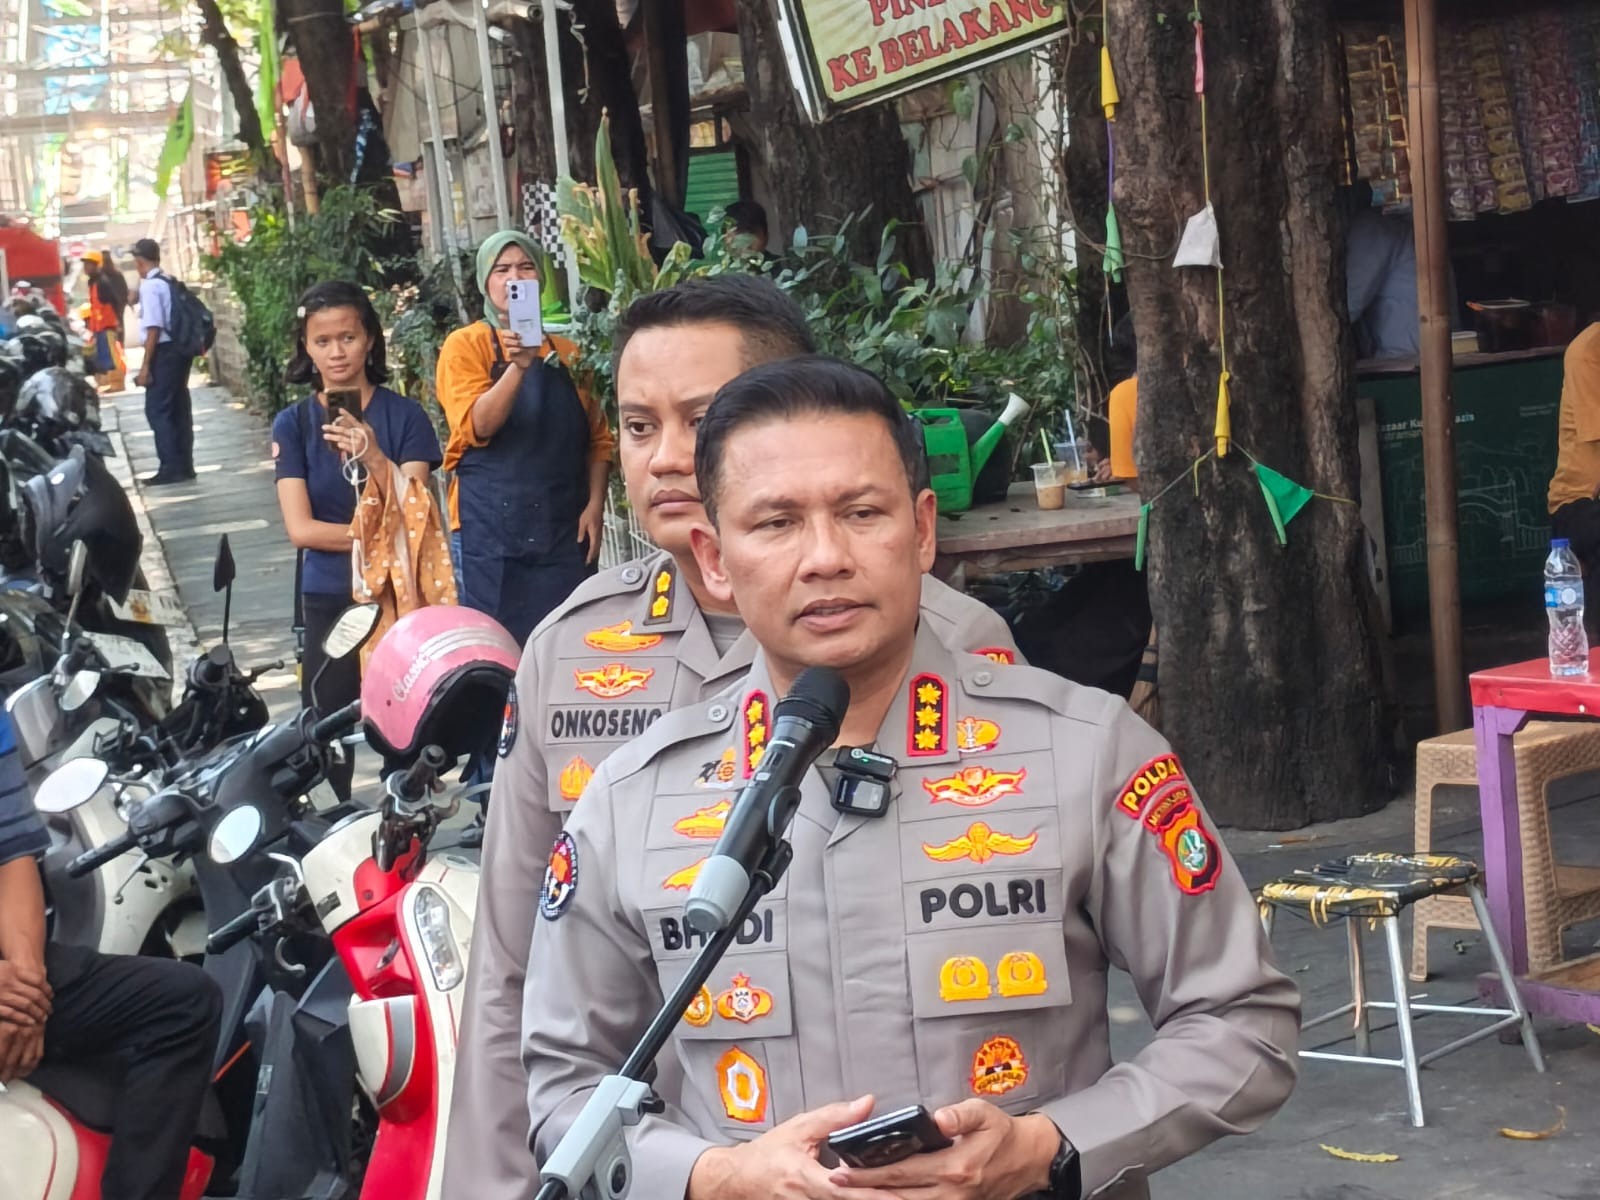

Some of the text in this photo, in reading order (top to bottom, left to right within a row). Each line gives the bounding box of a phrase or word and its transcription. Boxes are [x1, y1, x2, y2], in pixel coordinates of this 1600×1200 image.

[826, 46, 877, 92] KE
[1123, 758, 1179, 811] POLDA
[920, 878, 1046, 923] POLRI
[660, 908, 773, 951] BHDI
